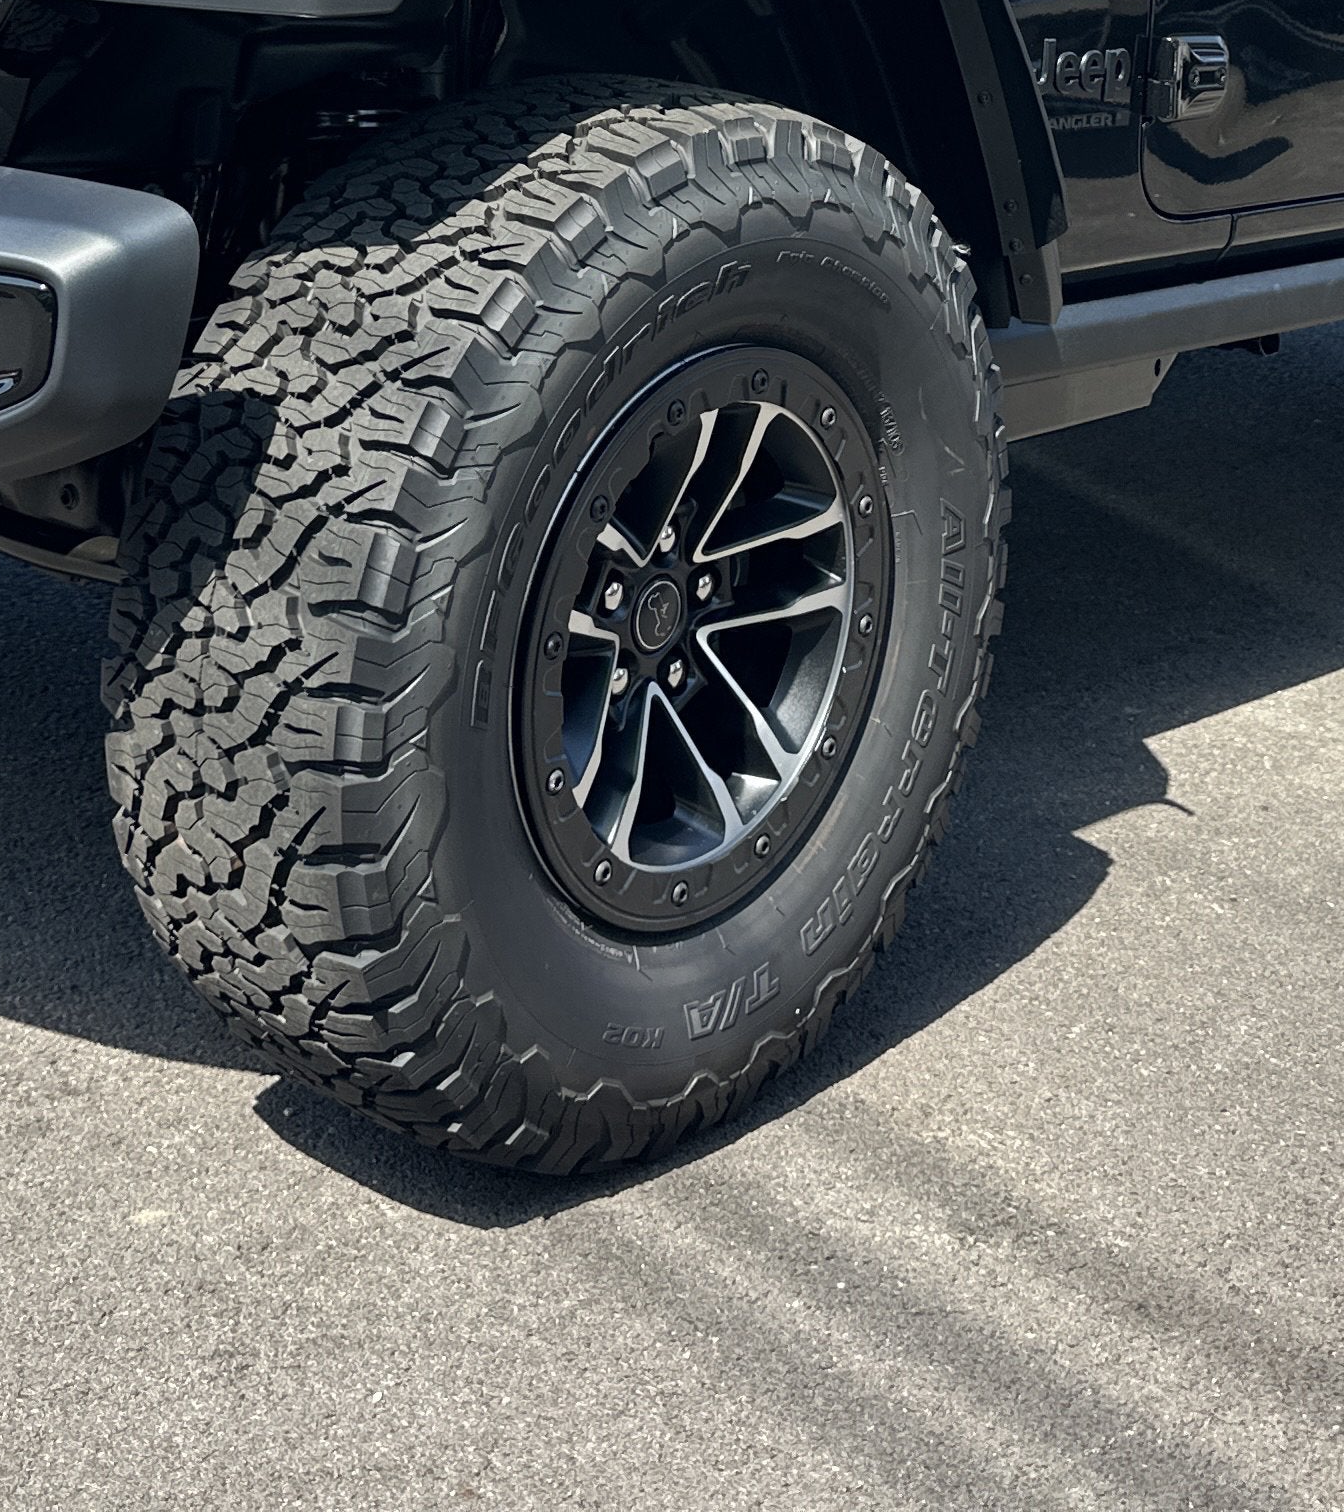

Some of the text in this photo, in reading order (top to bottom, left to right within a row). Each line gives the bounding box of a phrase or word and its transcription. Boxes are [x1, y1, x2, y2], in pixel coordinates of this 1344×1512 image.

[1037, 38, 1131, 104] Jeep
[1048, 113, 1114, 130] ANGLER
[470, 259, 753, 731] BFGoodrich
[800, 497, 968, 956] All-Terrain
[683, 960, 781, 1041] T/A
